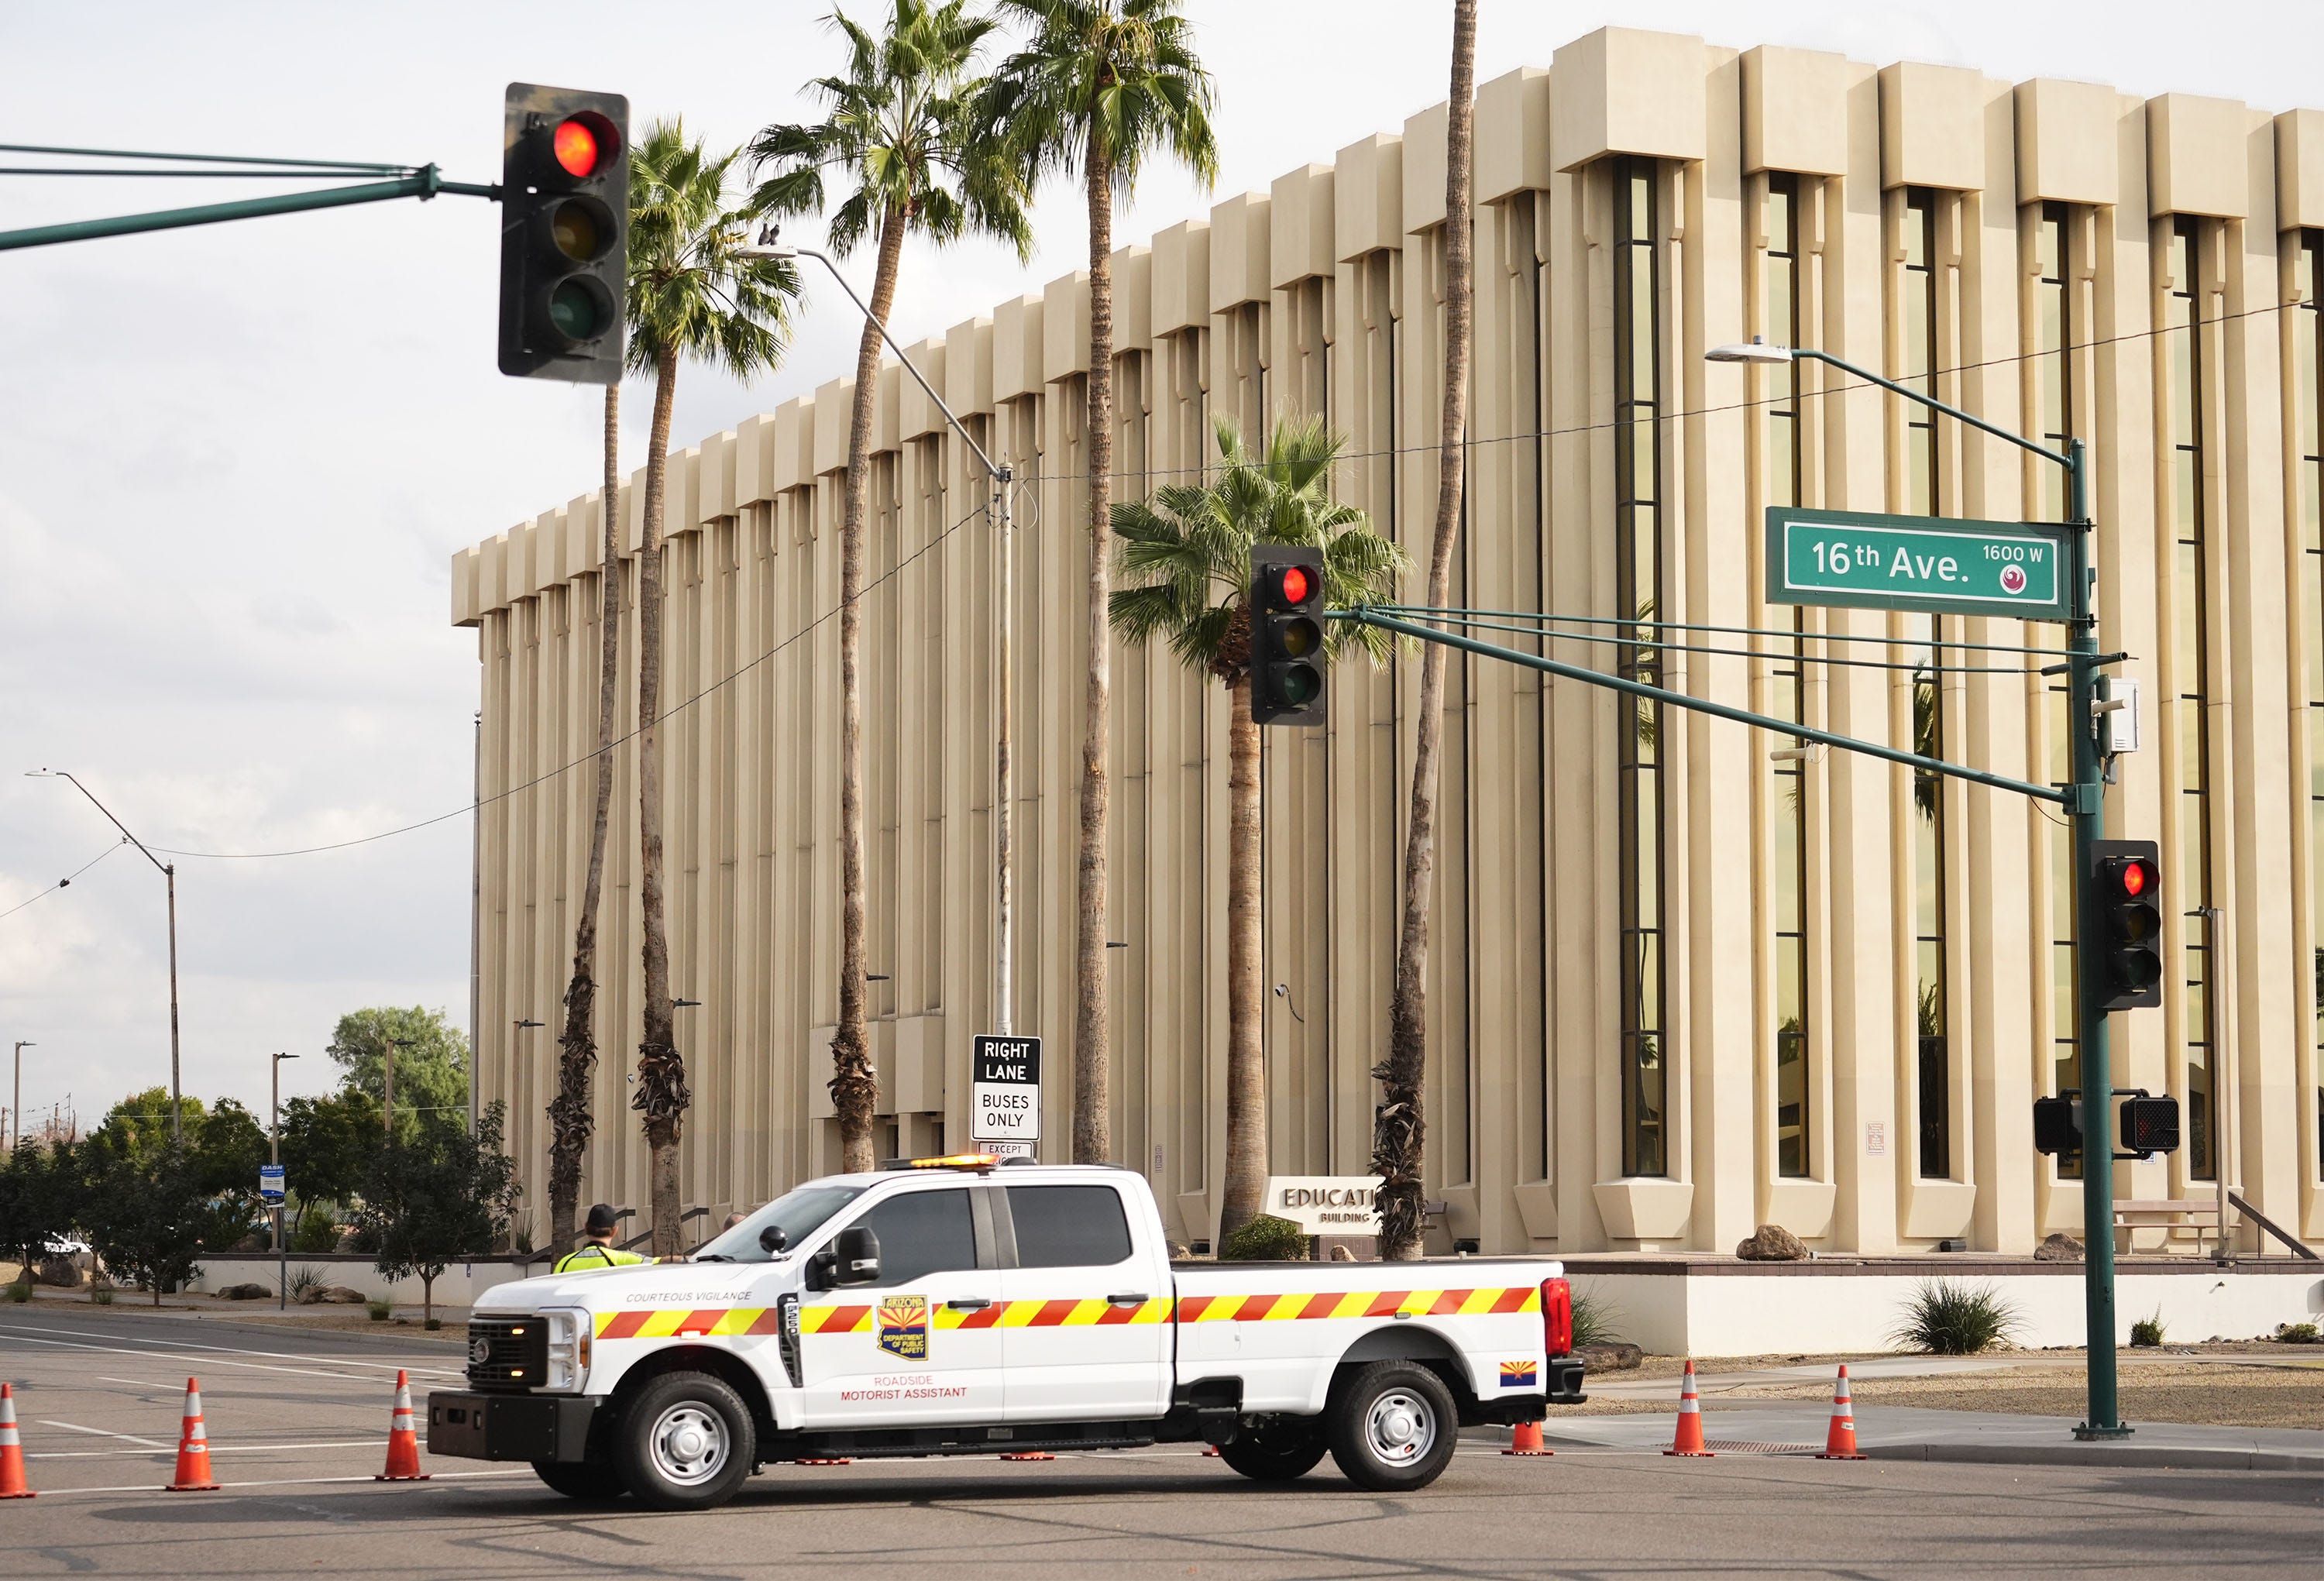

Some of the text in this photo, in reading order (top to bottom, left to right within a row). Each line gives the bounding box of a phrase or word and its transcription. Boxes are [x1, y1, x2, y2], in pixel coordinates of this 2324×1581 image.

[1982, 545, 2044, 563] 1600 W
[1812, 541, 1969, 583] 16th Ave.
[985, 1042, 1030, 1058] RIGHT
[985, 1064, 1026, 1081] LANE
[982, 1094, 1029, 1109] BUSES
[987, 1112, 1024, 1127] ONLY
[989, 1145, 1022, 1153] EXCEPT
[1284, 1188, 1375, 1207] EDUCATI
[1320, 1212, 1370, 1223] BUILDING
[626, 1291, 752, 1302] COURTEOUS VIGILANCE
[885, 1297, 924, 1308] ARIZONA
[874, 1375, 933, 1387] ROADSIDE
[841, 1387, 968, 1401] MOTORIST ASSISTANT
